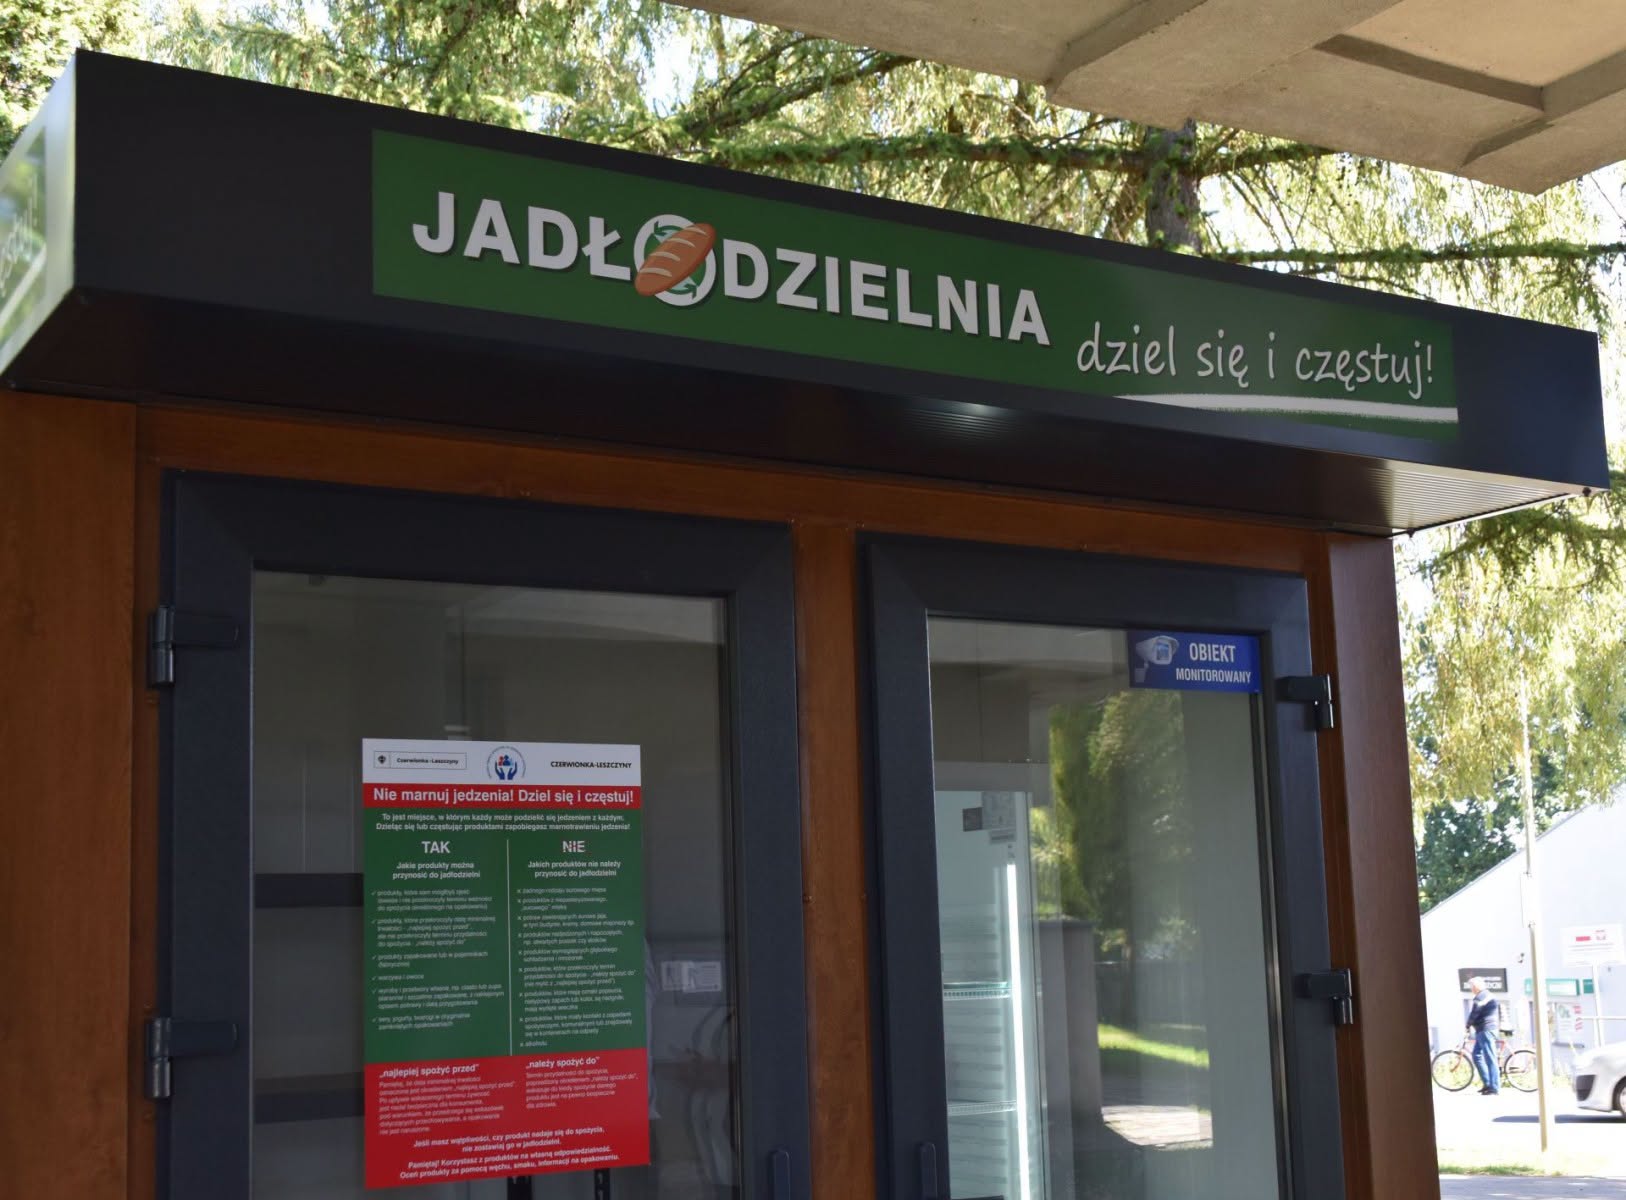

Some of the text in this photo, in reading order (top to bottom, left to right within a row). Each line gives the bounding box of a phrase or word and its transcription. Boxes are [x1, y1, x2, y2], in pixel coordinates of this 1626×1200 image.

[1076, 321, 1433, 400] dziel się i częstuj!
[1189, 642, 1236, 663] OBIEKT
[1175, 668, 1251, 683] MONITOROWANY
[373, 788, 634, 805] Nie marnuj jedzenia! Dziel się i częstuj!
[422, 841, 451, 854] TAK
[563, 841, 586, 852] NIE
[421, 1065, 450, 1075] spożyć
[557, 1058, 584, 1068] spożyć
